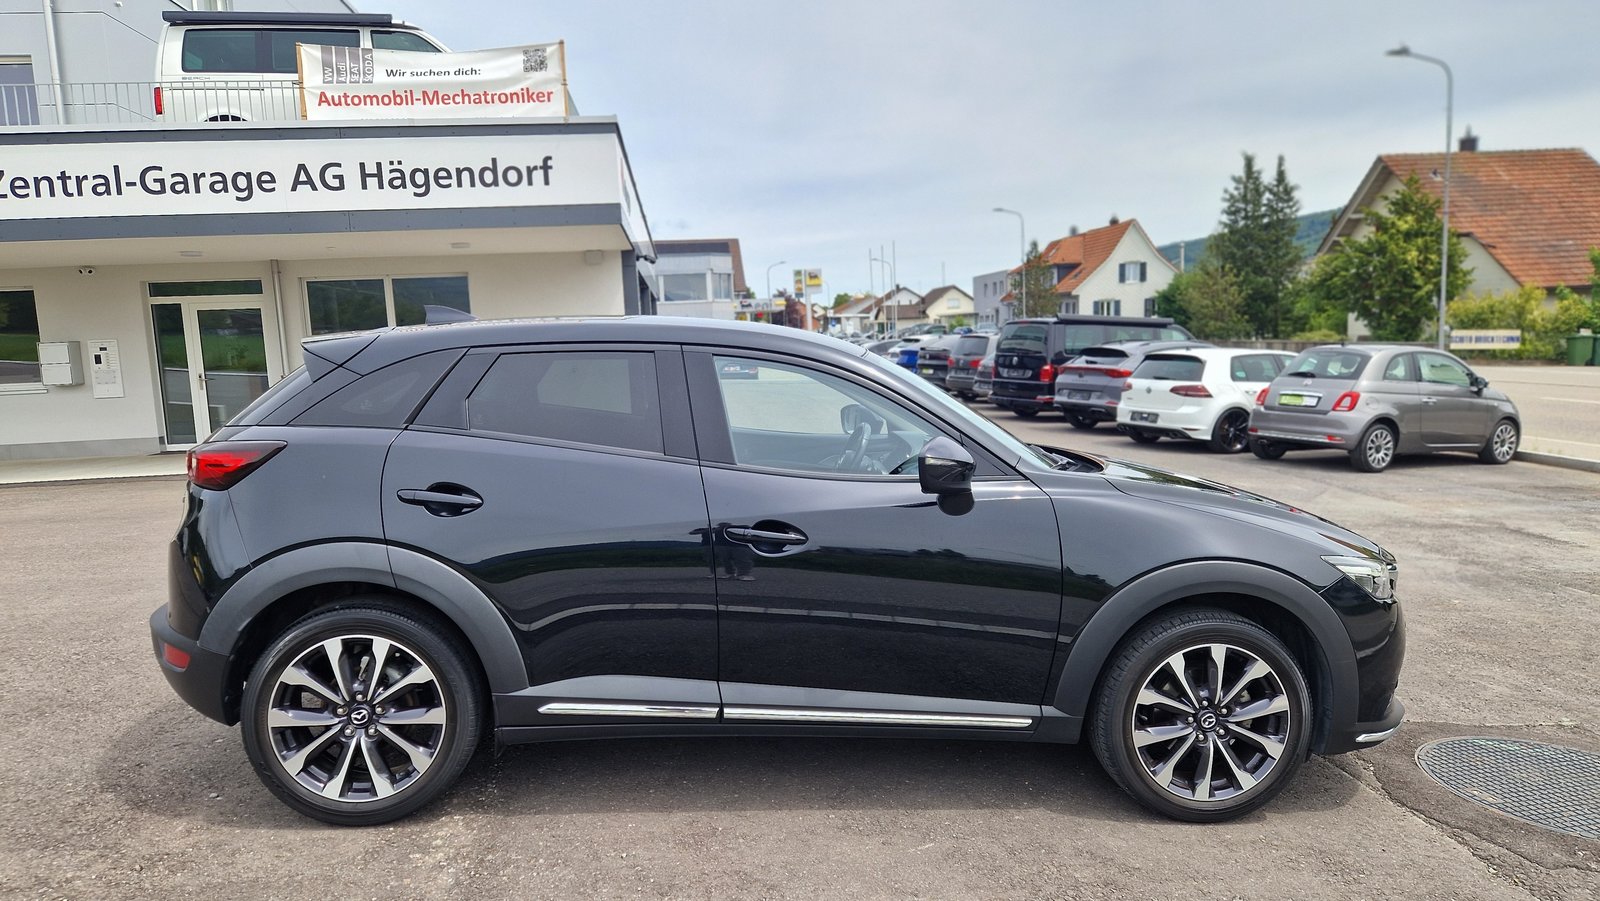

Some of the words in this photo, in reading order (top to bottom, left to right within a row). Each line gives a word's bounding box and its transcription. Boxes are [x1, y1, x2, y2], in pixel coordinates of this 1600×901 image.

[323, 66, 333, 82] VW
[337, 62, 346, 82] Audi
[350, 62, 359, 82] SEAT
[385, 68, 407, 77] Wir
[410, 68, 450, 77] suchen
[453, 67, 481, 76] dich:
[318, 87, 554, 107] Automobil-Mechatroniker
[290, 162, 346, 192] AG
[359, 155, 553, 198] Hägendorf
